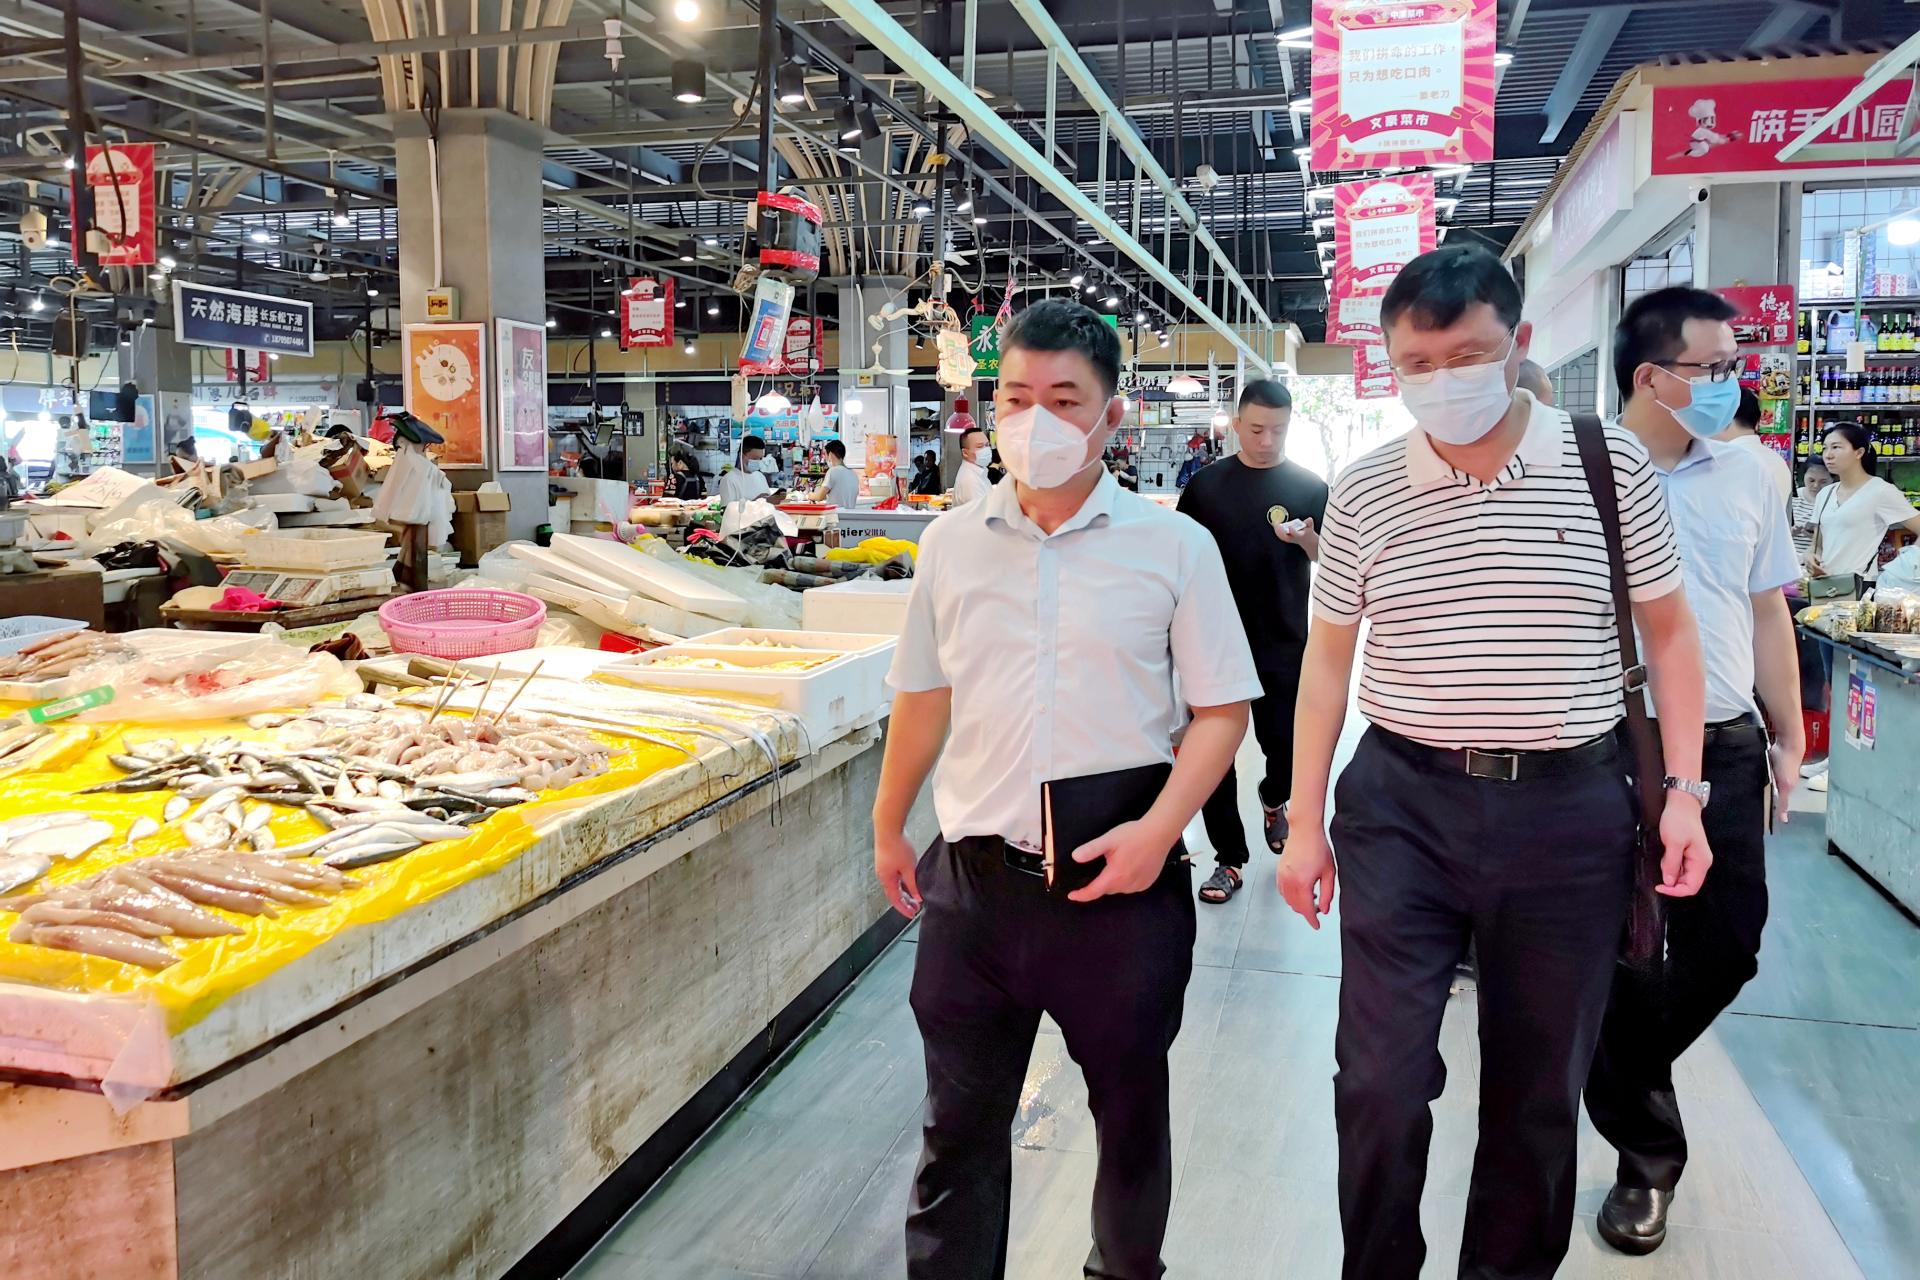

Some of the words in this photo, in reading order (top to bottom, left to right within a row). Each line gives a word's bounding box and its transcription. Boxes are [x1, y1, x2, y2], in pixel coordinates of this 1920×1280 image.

[1348, 66, 1443, 83] 只为想吃口肉。
[1369, 113, 1430, 130] 文豪菜市
[190, 296, 259, 327] 天然海鲜
